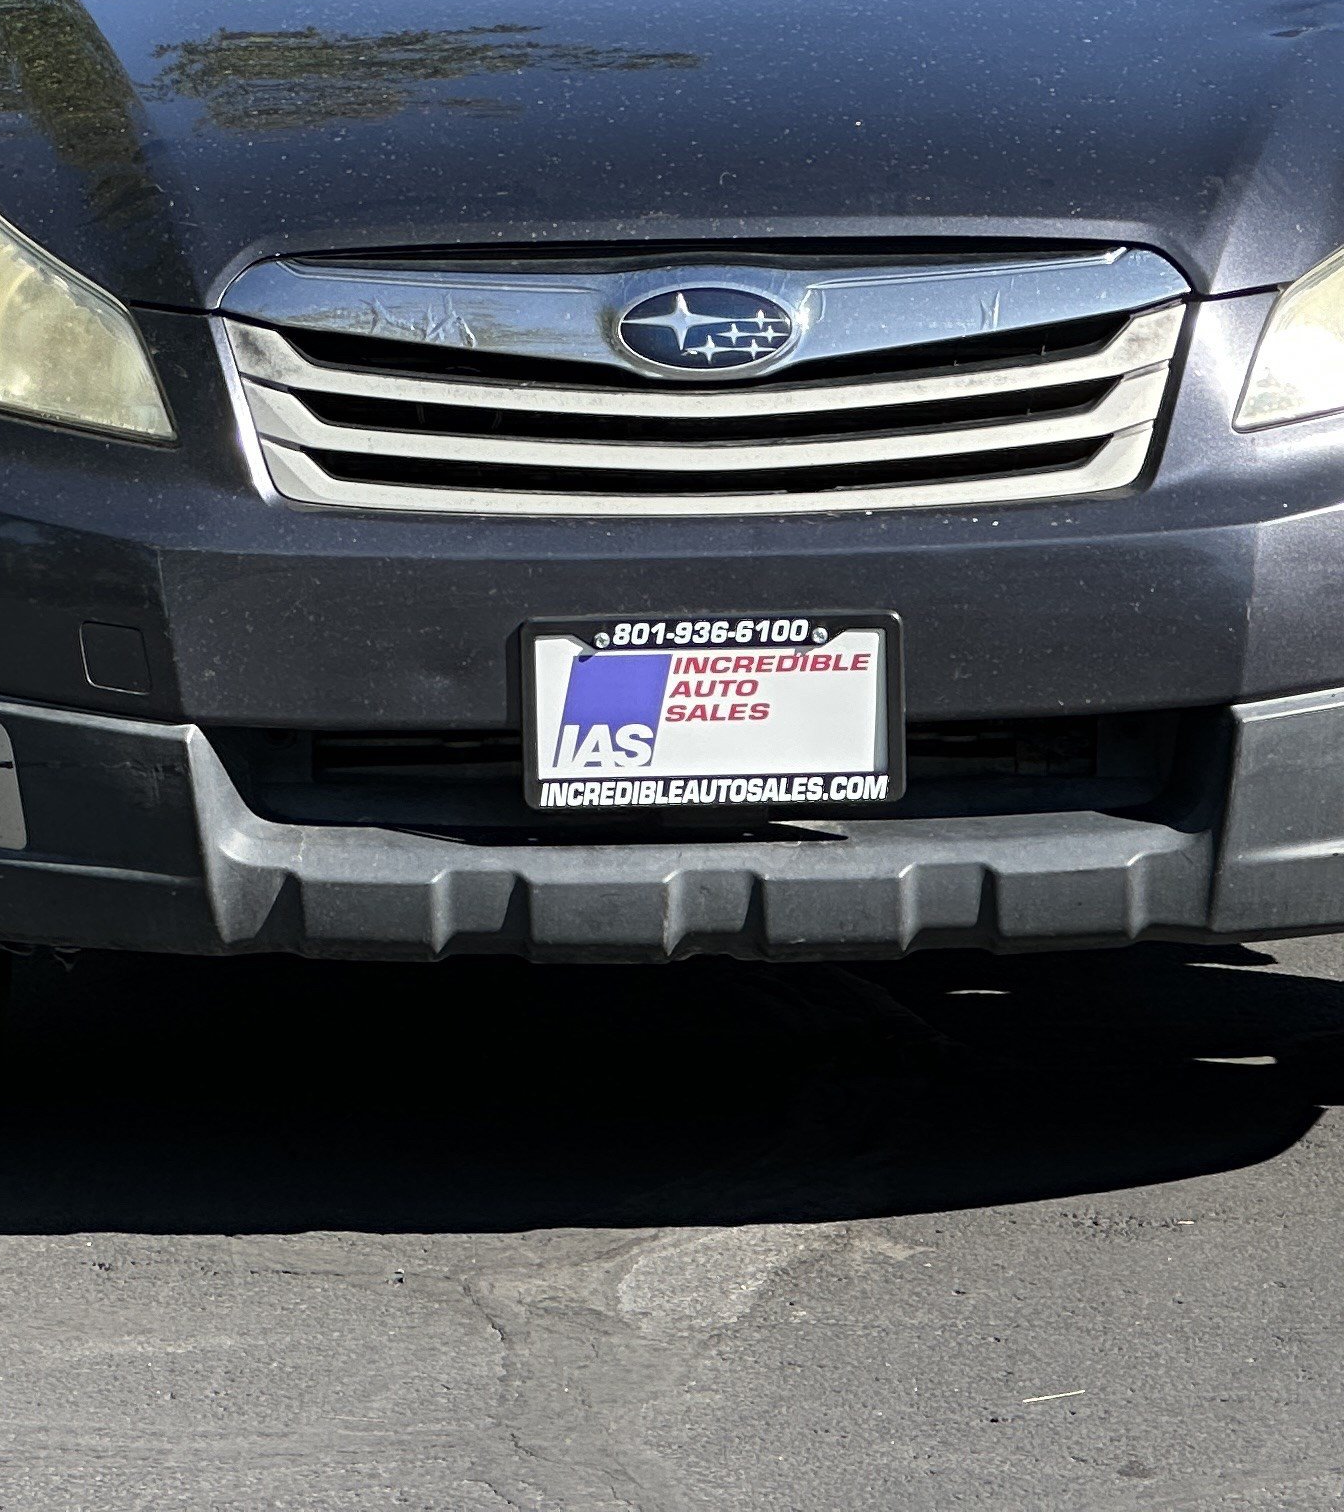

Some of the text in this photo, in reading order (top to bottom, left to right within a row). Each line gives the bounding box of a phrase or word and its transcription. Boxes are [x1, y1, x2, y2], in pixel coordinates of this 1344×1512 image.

[612, 619, 809, 646] 801-936-6100
[672, 653, 871, 675] INCREDIBLE
[669, 679, 759, 699] AUTO
[665, 703, 770, 723] SALES
[557, 723, 655, 768] IAS
[540, 775, 889, 808] INCREDIBLEAUTOSALES.COM
